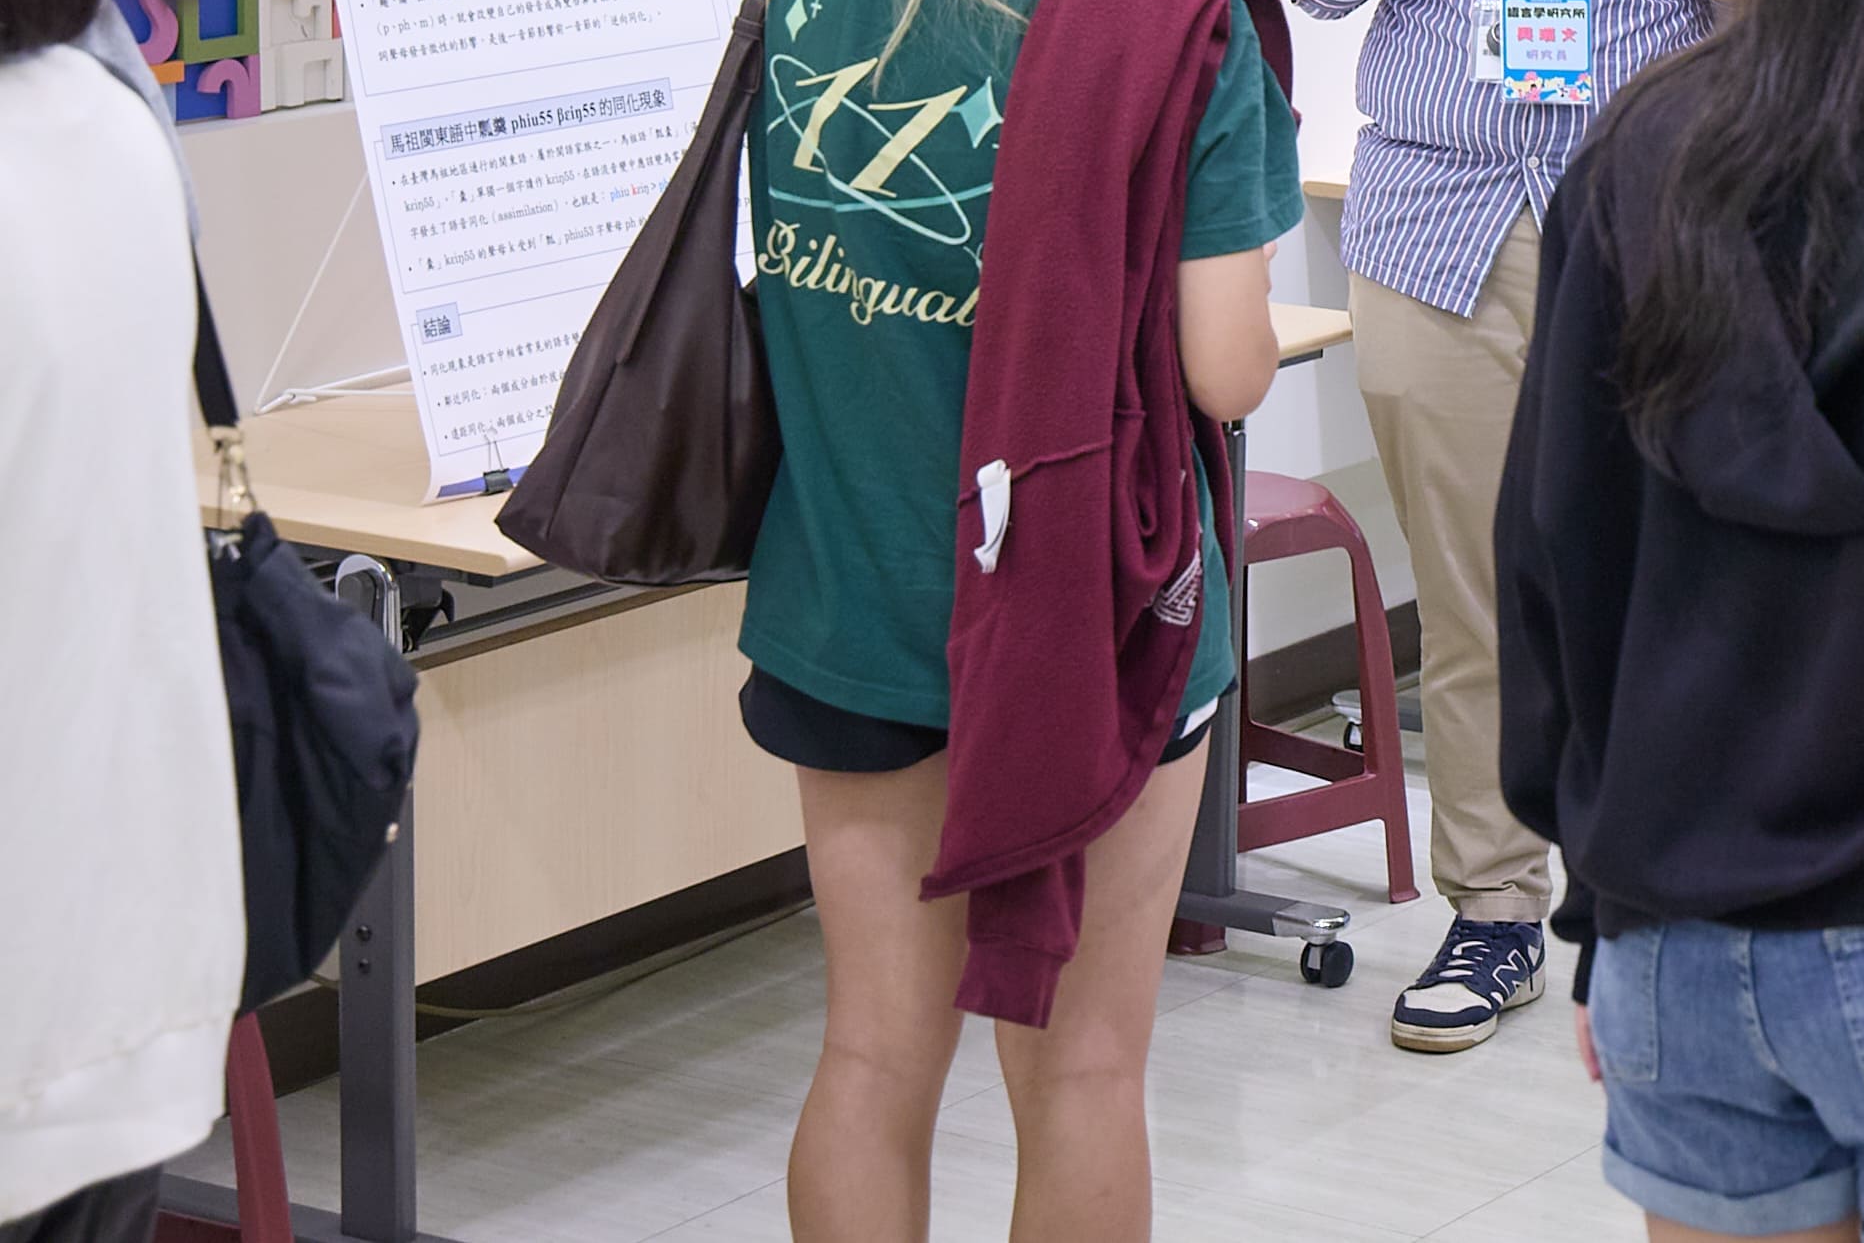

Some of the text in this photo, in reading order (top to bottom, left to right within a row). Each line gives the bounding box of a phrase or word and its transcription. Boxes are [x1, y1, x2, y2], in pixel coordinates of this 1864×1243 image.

[511, 109, 554, 134] phiu55
[600, 88, 667, 117] 的同化現象
[424, 314, 451, 338] 結論
